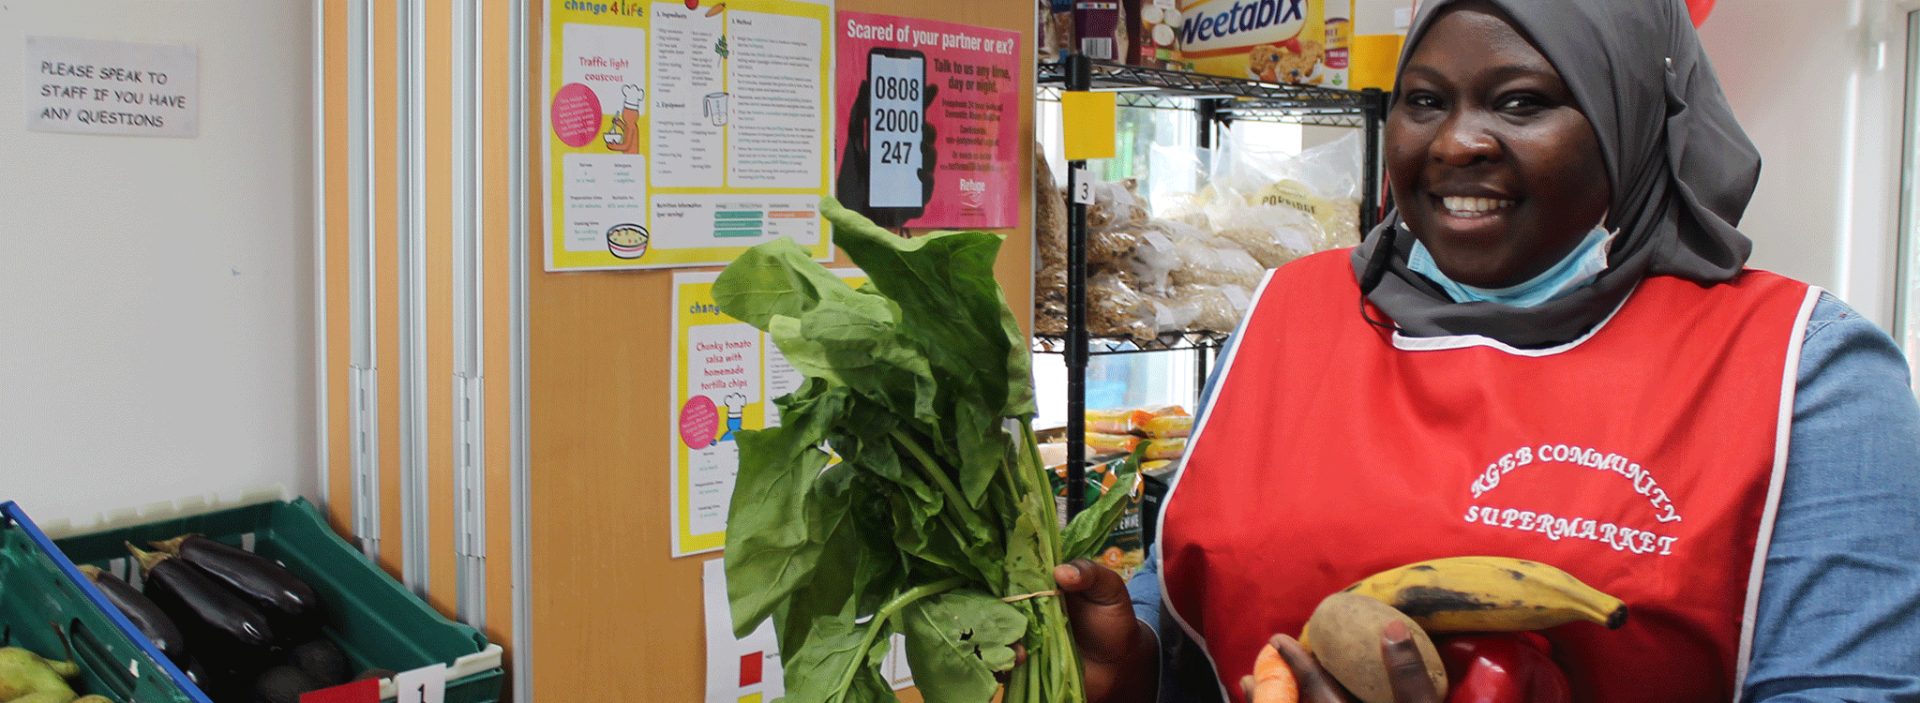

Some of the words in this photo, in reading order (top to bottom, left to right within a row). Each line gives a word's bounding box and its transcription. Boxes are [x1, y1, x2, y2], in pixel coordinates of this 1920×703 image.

[564, 0, 607, 15] change
[610, 1, 619, 16] 4
[847, 19, 894, 41] Scared
[896, 25, 910, 43] of
[912, 28, 939, 47] your
[942, 32, 982, 51] partner
[984, 39, 995, 53] or
[996, 37, 1014, 55] ex?
[40, 60, 94, 79] PLEASE
[98, 67, 143, 83] SPEAK
[147, 71, 168, 85] TO
[579, 56, 607, 68] Traffic
[609, 57, 629, 70] light
[933, 58, 952, 73] Talk
[953, 61, 962, 74] to
[964, 64, 973, 75] us
[976, 65, 990, 80] any
[584, 72, 624, 83] couscous
[948, 76, 963, 92] day
[965, 79, 974, 89] or
[40, 84, 88, 99] STAFF
[93, 88, 110, 102] IF
[114, 90, 144, 105] YOU
[149, 93, 187, 110] HAVE
[875, 76, 919, 101] 0808
[40, 107, 72, 120] ANY
[77, 108, 164, 128] QUESTIONS
[875, 108, 919, 133] 2000
[881, 141, 912, 164] 247
[960, 178, 985, 194] Refuge
[1081, 182, 1089, 200] 3
[690, 301, 720, 316] chang
[696, 340, 723, 352] Chunky
[725, 339, 752, 349] tomato
[705, 353, 723, 364] salsa
[725, 352, 743, 362] with
[704, 364, 744, 376] homemade
[701, 379, 726, 390] tortilla
[728, 378, 748, 389] chips
[1471, 446, 1534, 499] KGEB
[1538, 444, 1682, 523] COMMUNITY
[1464, 505, 1678, 556] SUPERMARKET
[417, 683, 427, 703] 1
